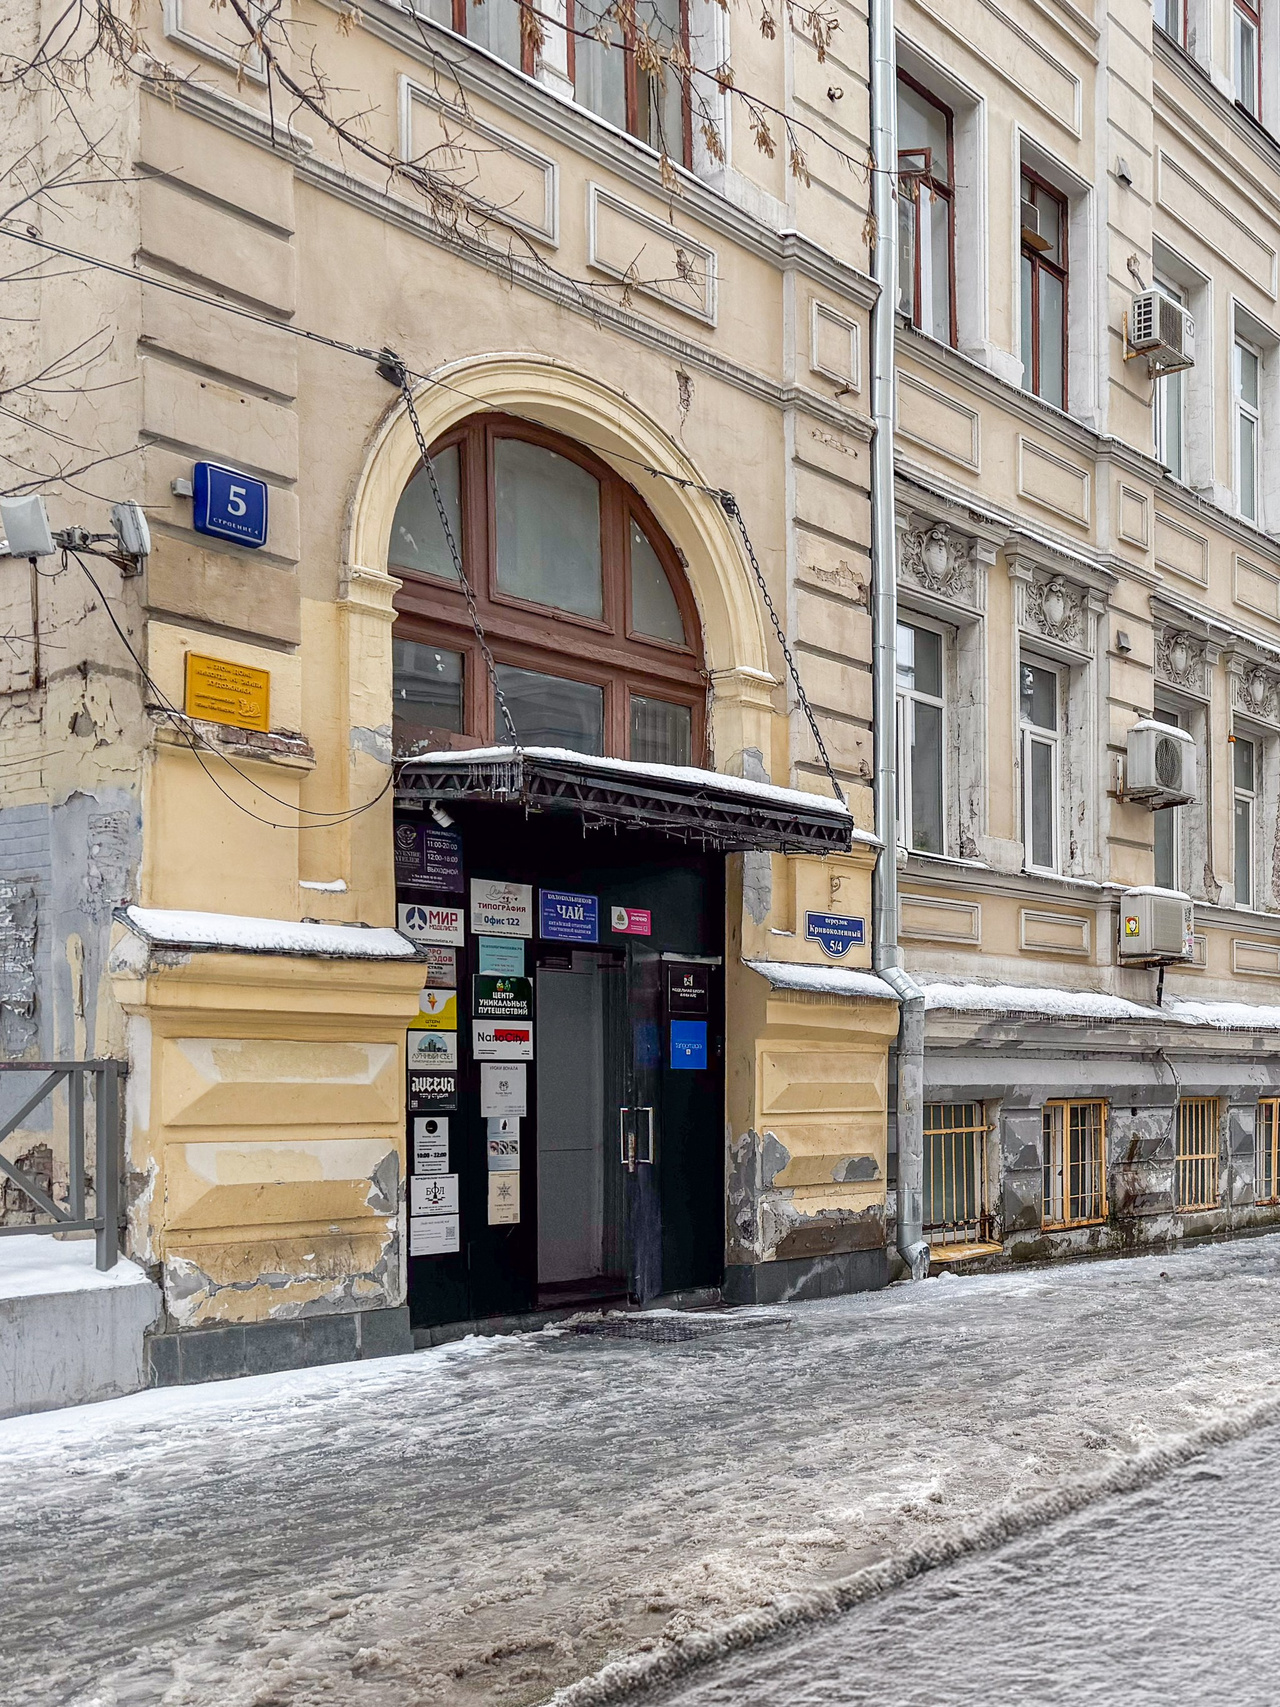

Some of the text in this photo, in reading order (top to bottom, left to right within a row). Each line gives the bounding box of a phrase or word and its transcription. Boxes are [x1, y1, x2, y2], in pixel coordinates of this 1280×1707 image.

[227, 484, 247, 516] 5
[213, 517, 253, 533] СТРОЕНИЕ
[477, 902, 527, 913] ТИПОГРАФИЯ
[556, 903, 584, 921] ЧАЙ
[428, 910, 458, 926] МИР
[483, 915, 520, 927] Офис 122
[809, 924, 862, 938] Кривоколенный
[829, 940, 843, 952] 5/4
[492, 991, 514, 1000] ЦЕНТР
[479, 998, 528, 1008] УНИКАЛЬНЫХ
[478, 1006, 529, 1015] ПУТЕШЕСТВИЙ
[411, 1052, 439, 1060] ЛУННЫЙ
[425, 1186, 445, 1196] БФЛ
